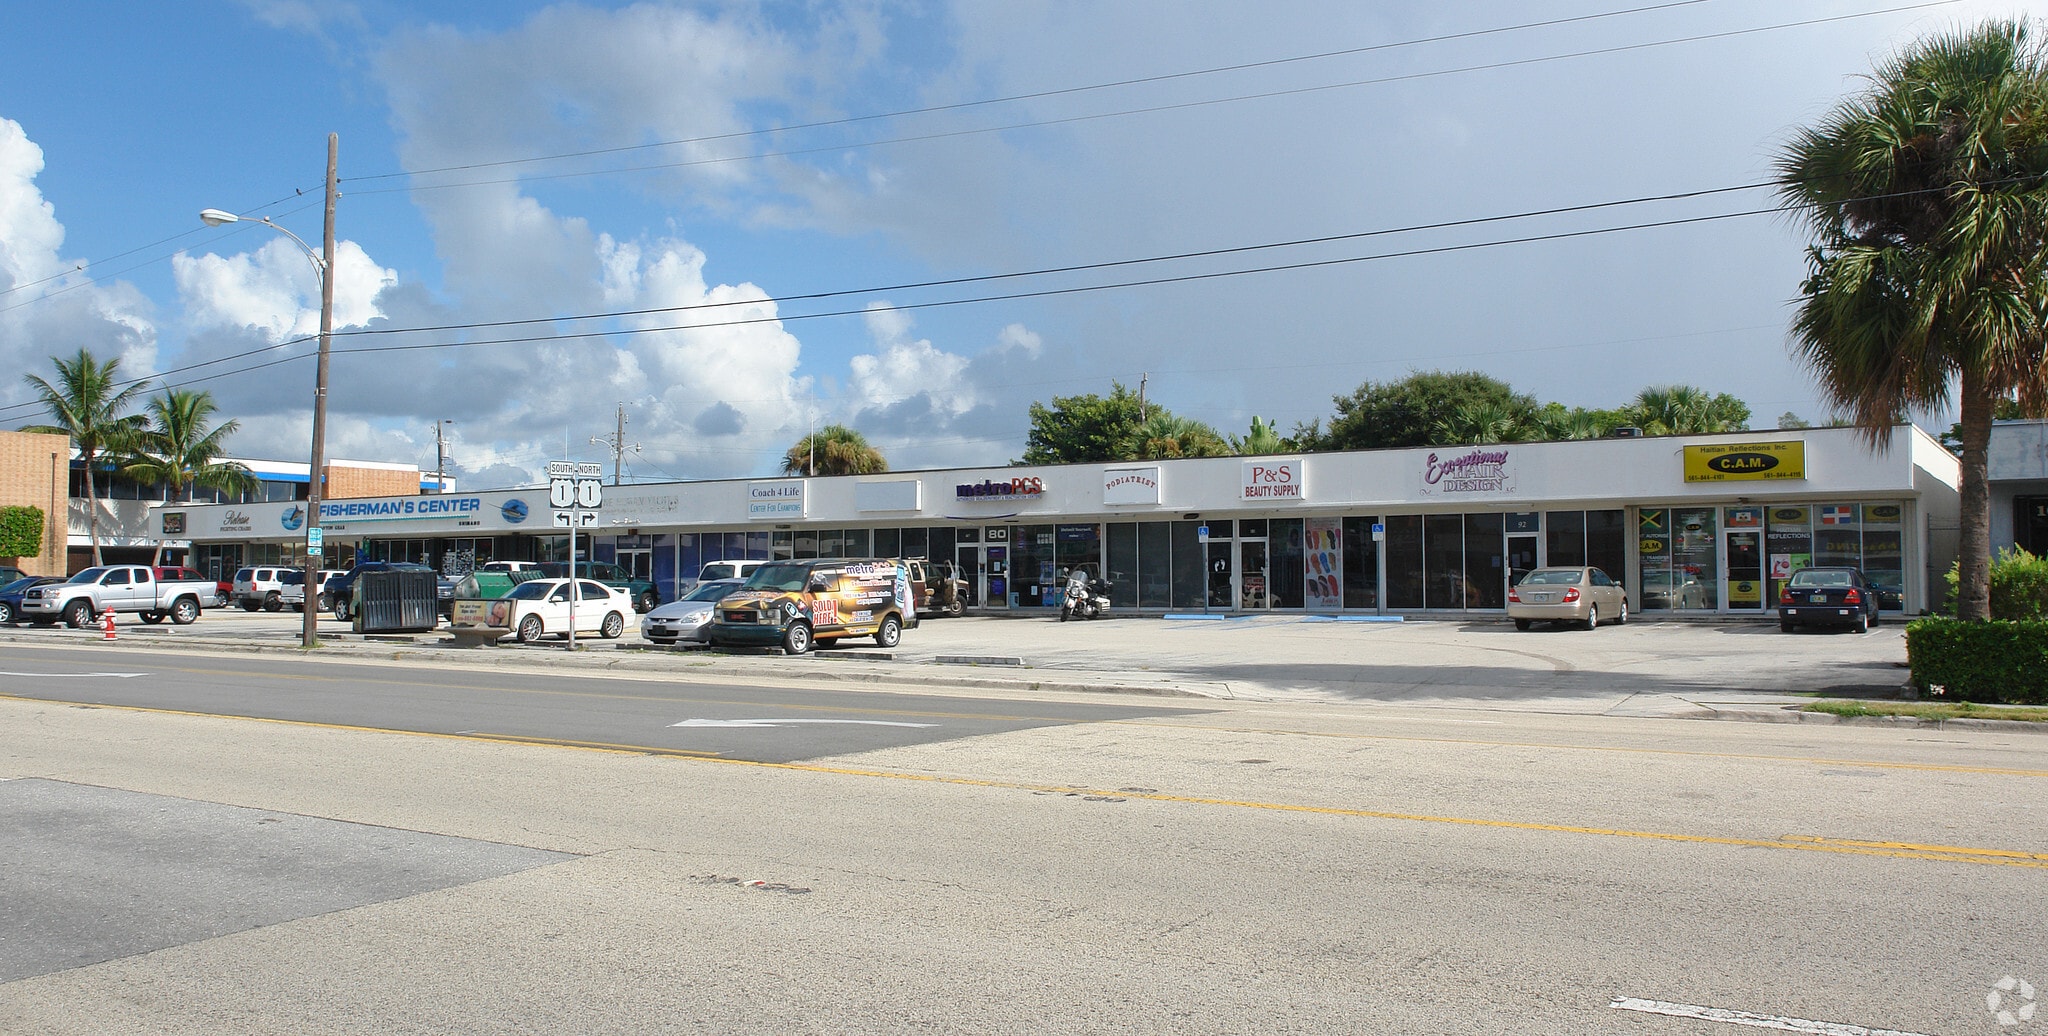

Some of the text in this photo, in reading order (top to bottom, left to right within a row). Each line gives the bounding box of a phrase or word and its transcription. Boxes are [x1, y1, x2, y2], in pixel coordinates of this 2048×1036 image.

[1700, 443, 1788, 454] Haitian Reflections Inc.
[551, 463, 573, 473] SOUTH
[579, 465, 601, 474] NORTH
[1425, 449, 1509, 484] Exceptional
[1720, 457, 1766, 469] C.A.M.
[1252, 465, 1292, 484] P&S
[1452, 464, 1509, 479] HAIR
[956, 476, 1042, 497] metroPCS
[1105, 475, 1156, 490] PODIATRIST
[1443, 479, 1503, 492] DESIGN
[560, 485, 565, 501] 1
[588, 485, 592, 501] 1
[752, 487, 800, 498] Coach 4 Life
[1245, 484, 1300, 497] BEAUTY SUPPLY
[319, 498, 481, 516] FISHERMAN'S CENTER
[1517, 520, 1527, 528] 92
[988, 529, 1006, 539] 80
[813, 600, 832, 613] SOLD
